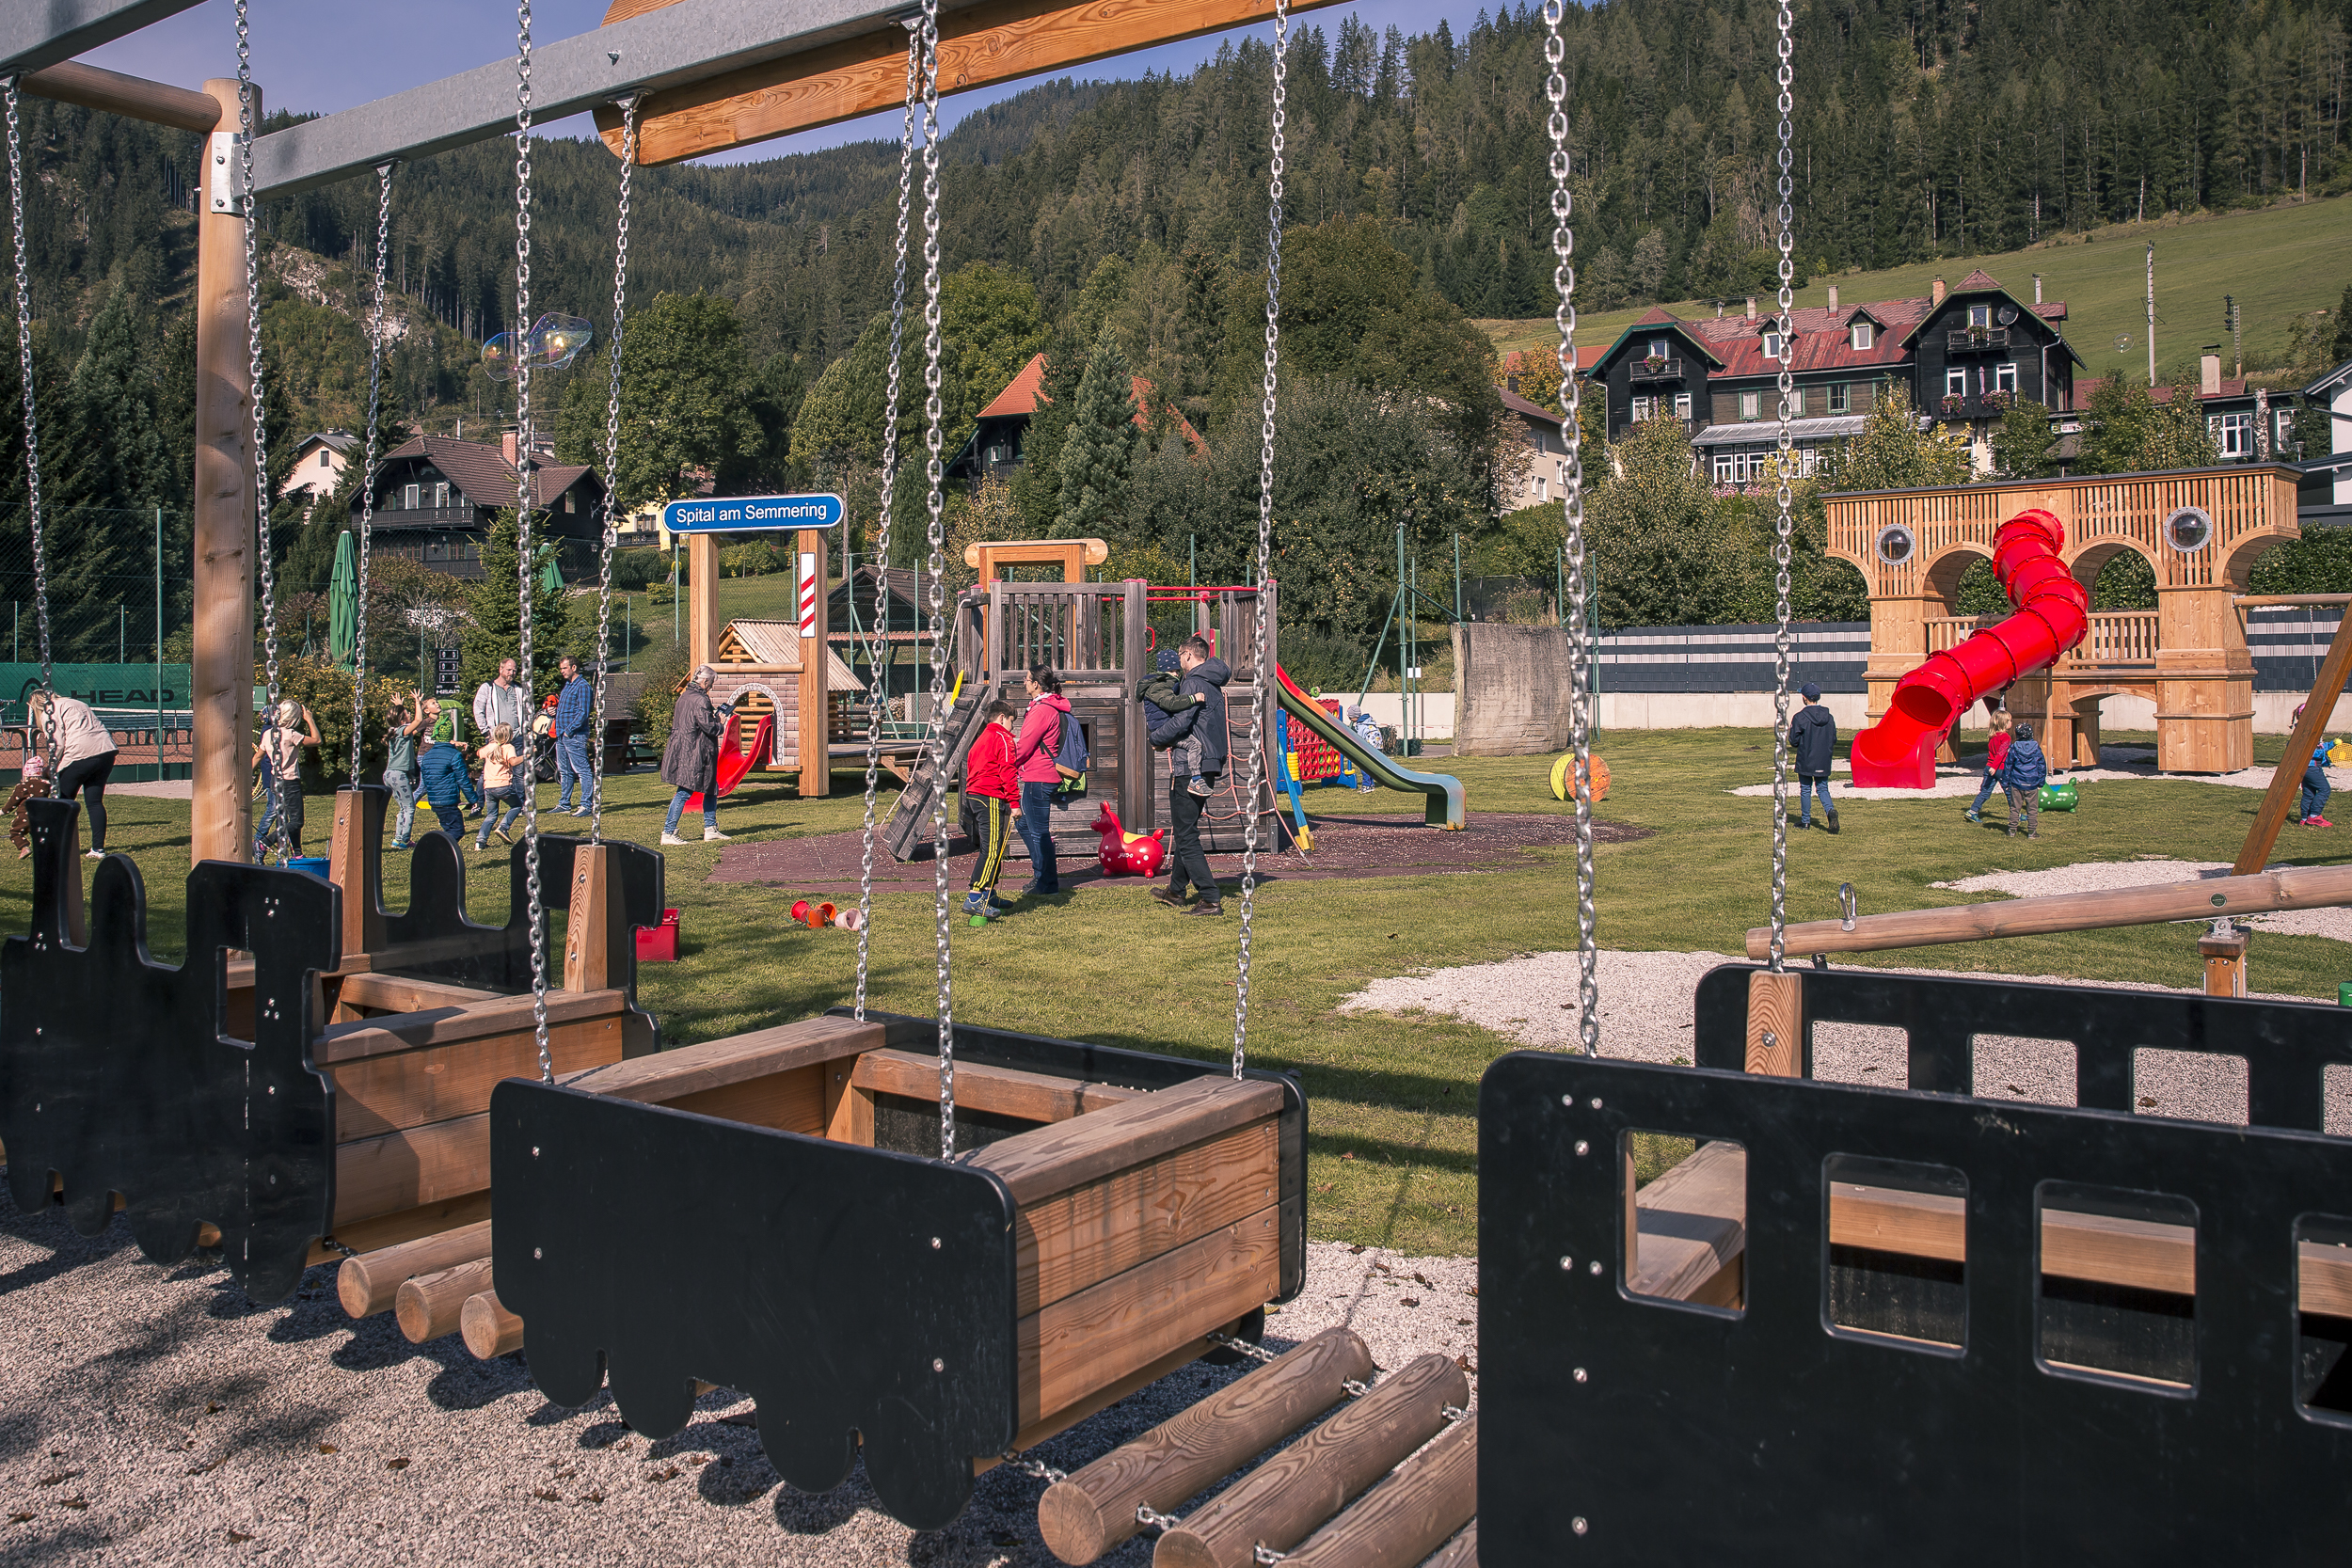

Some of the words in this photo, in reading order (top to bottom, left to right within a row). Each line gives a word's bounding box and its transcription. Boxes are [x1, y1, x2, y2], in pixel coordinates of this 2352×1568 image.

[676, 507, 715, 526] Spital
[719, 508, 740, 521] am
[745, 502, 827, 520] Semmering
[71, 689, 175, 704] HEAD
